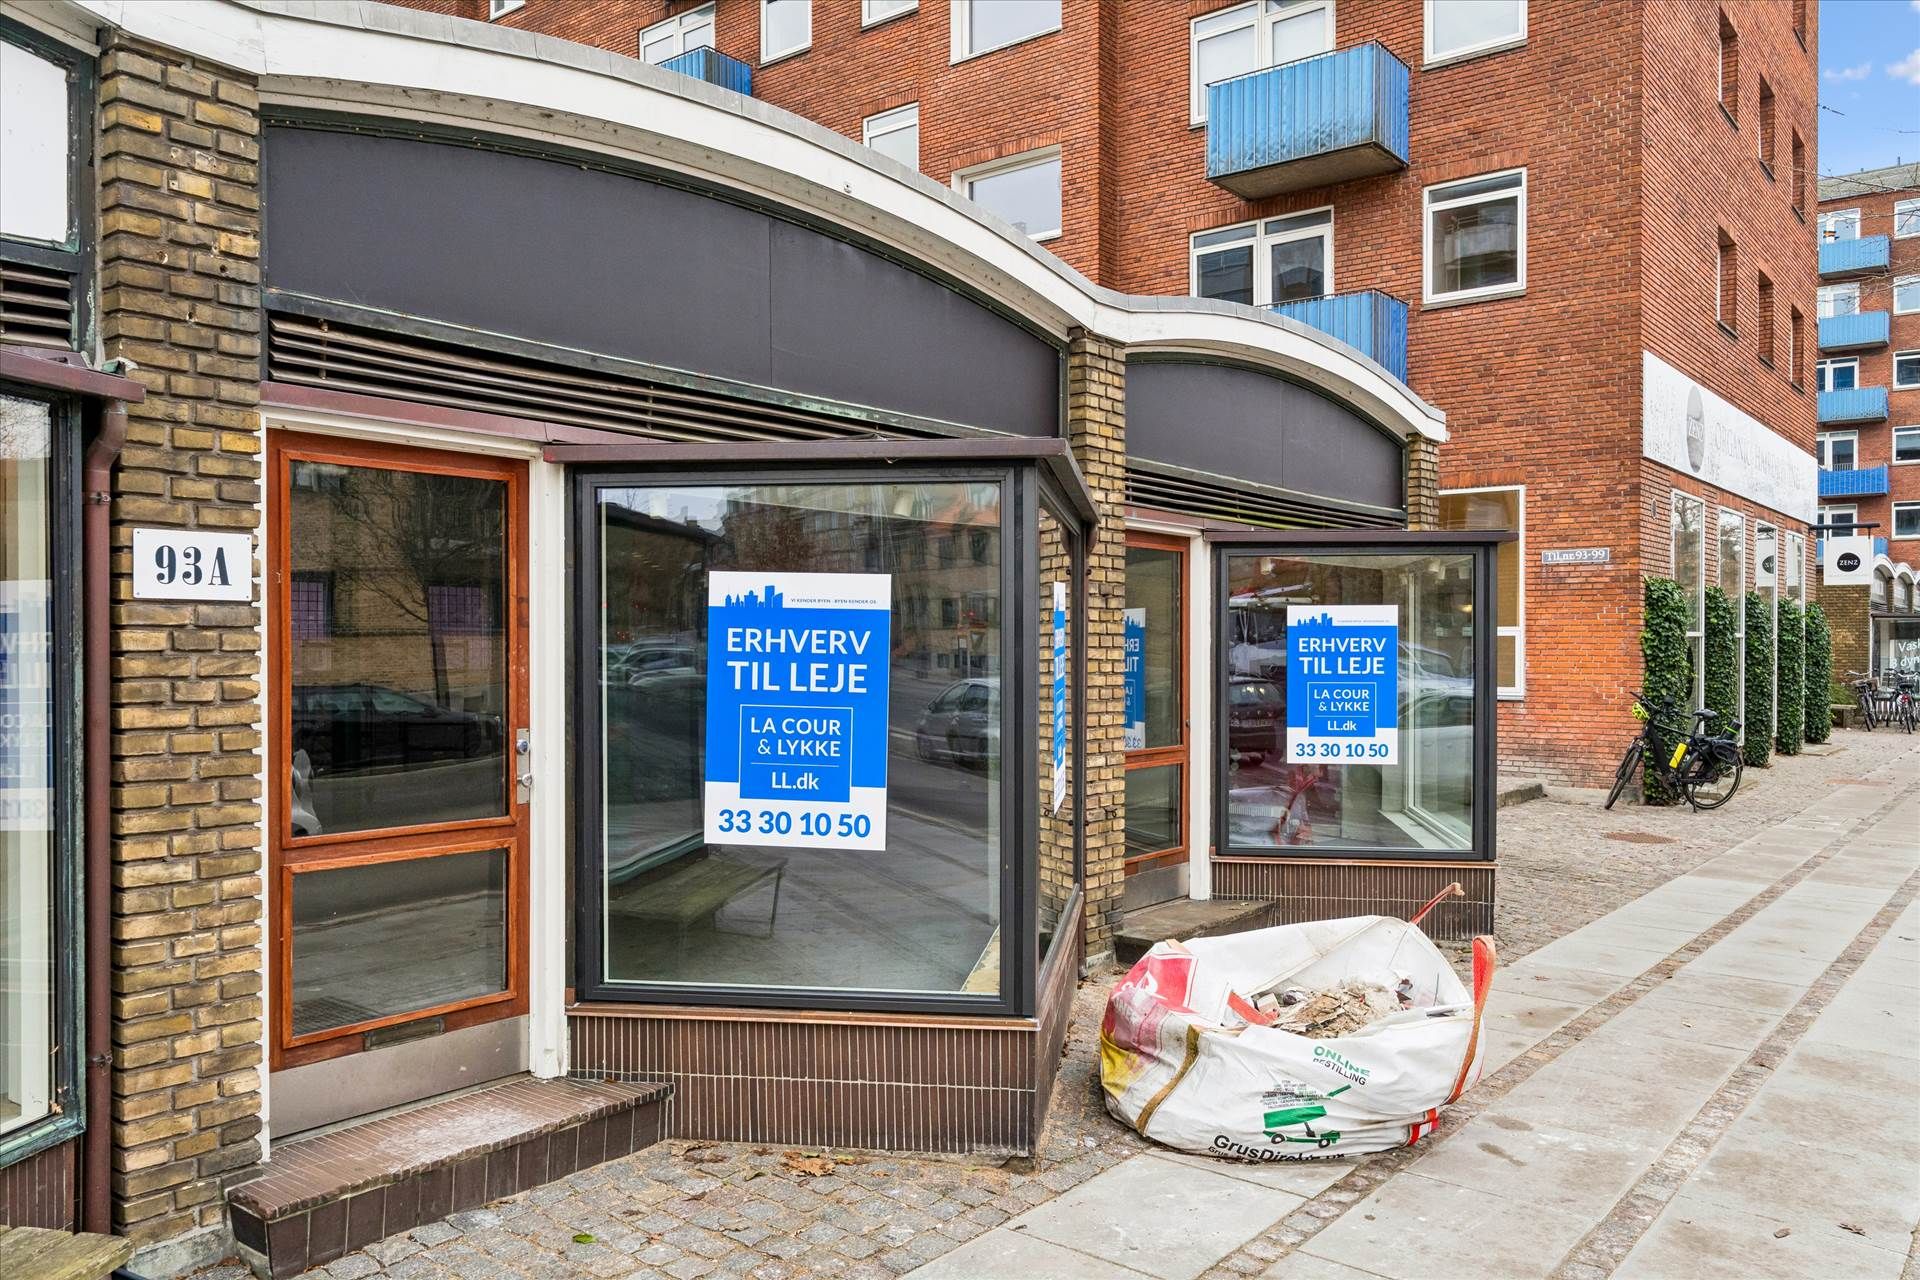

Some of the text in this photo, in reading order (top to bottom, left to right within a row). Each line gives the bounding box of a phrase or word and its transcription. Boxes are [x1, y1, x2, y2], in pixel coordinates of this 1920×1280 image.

[155, 545, 232, 586] 93A
[727, 628, 871, 655] ERHVERV
[1298, 638, 1386, 652] ERHVERV
[1299, 657, 1385, 675] TIL LEJE
[727, 661, 868, 693] TIL LEJE
[1314, 689, 1369, 699] LA COUR
[1318, 702, 1369, 711] & LYKKE
[751, 717, 841, 735] LA COUR
[1327, 720, 1357, 731] LL.dk
[758, 739, 840, 757] & LYKKE
[1296, 743, 1389, 757] 33 30 10 50
[771, 772, 819, 790] LL.dk
[718, 809, 871, 838] 33 30 10 50
[1314, 1046, 1370, 1077] ONLINE
